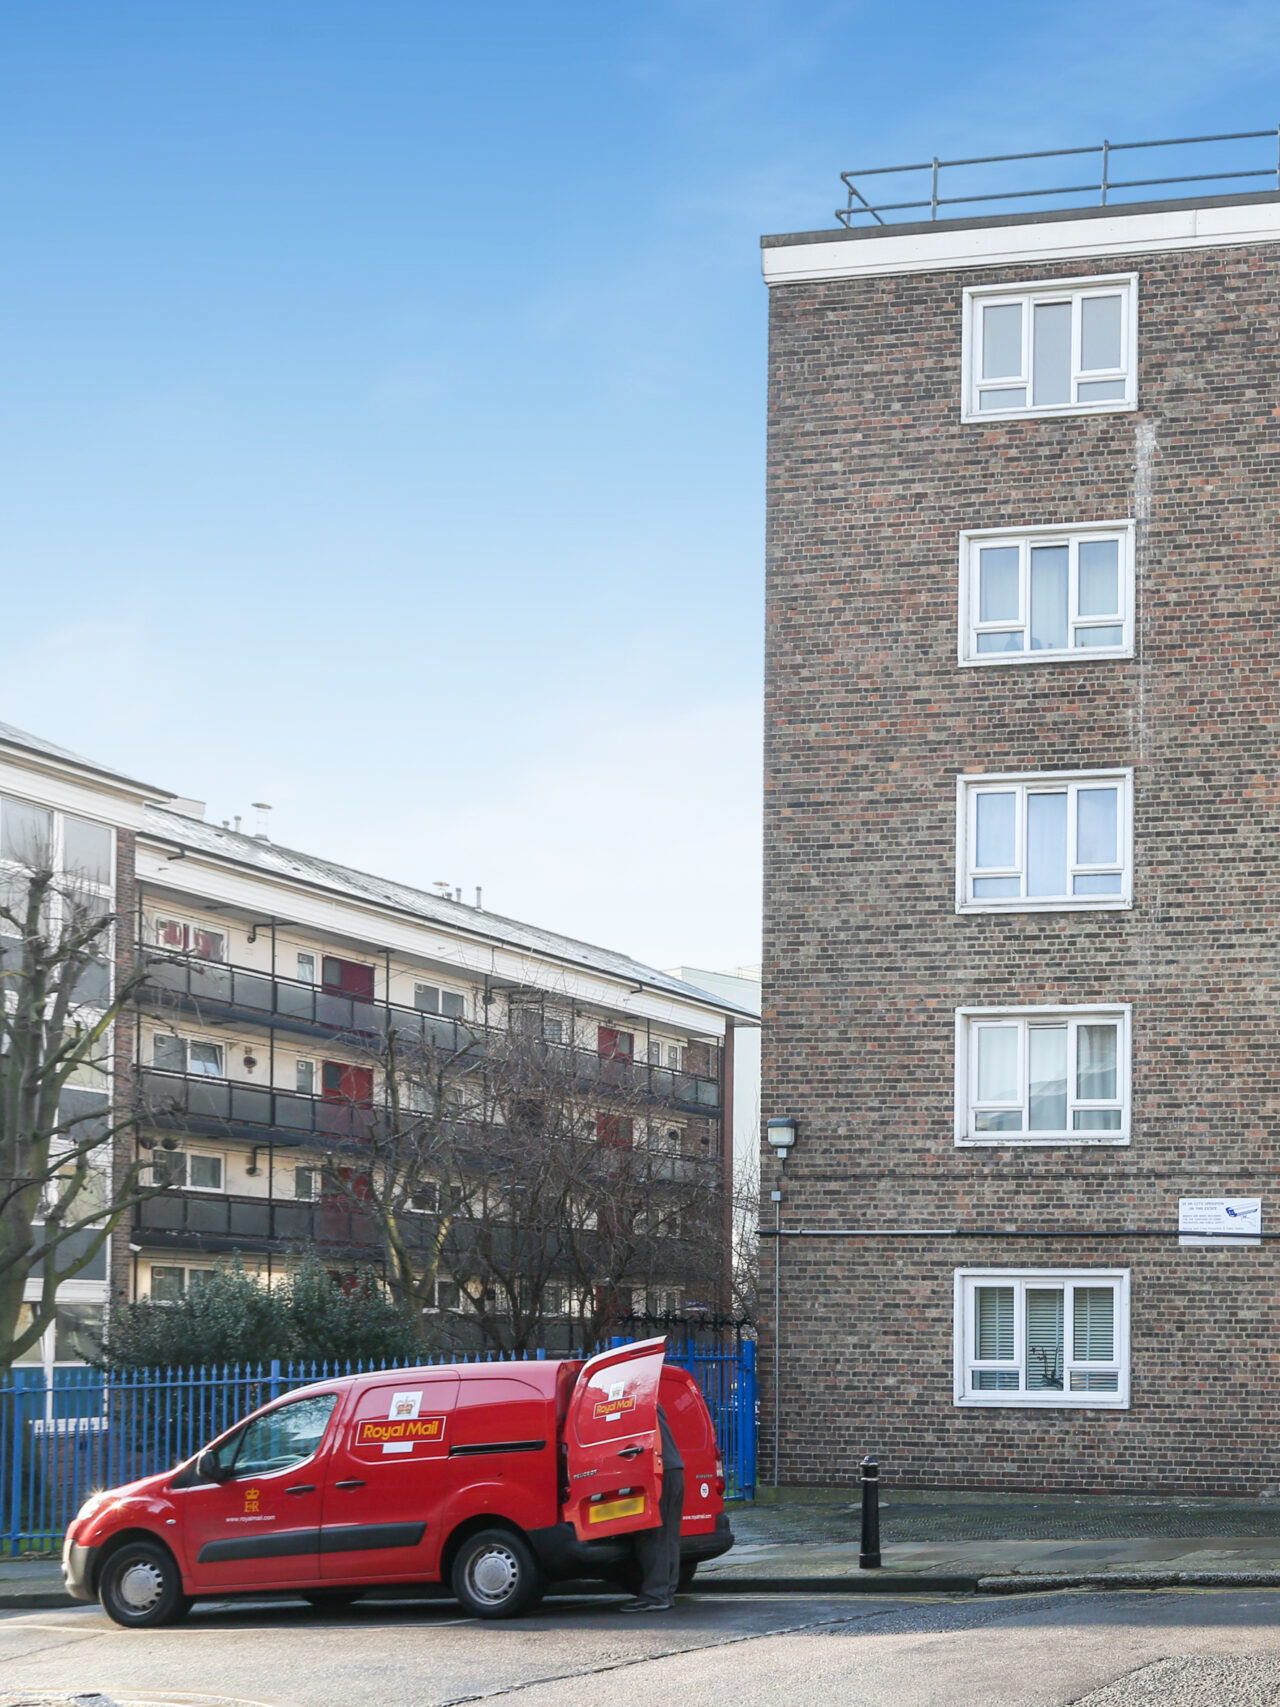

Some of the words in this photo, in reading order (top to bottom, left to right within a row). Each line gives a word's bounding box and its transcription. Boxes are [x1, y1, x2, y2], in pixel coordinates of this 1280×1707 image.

[596, 1401, 617, 1415] Royal
[617, 1398, 634, 1410] Mail
[362, 1422, 405, 1440] Royal
[406, 1420, 440, 1436] Mail
